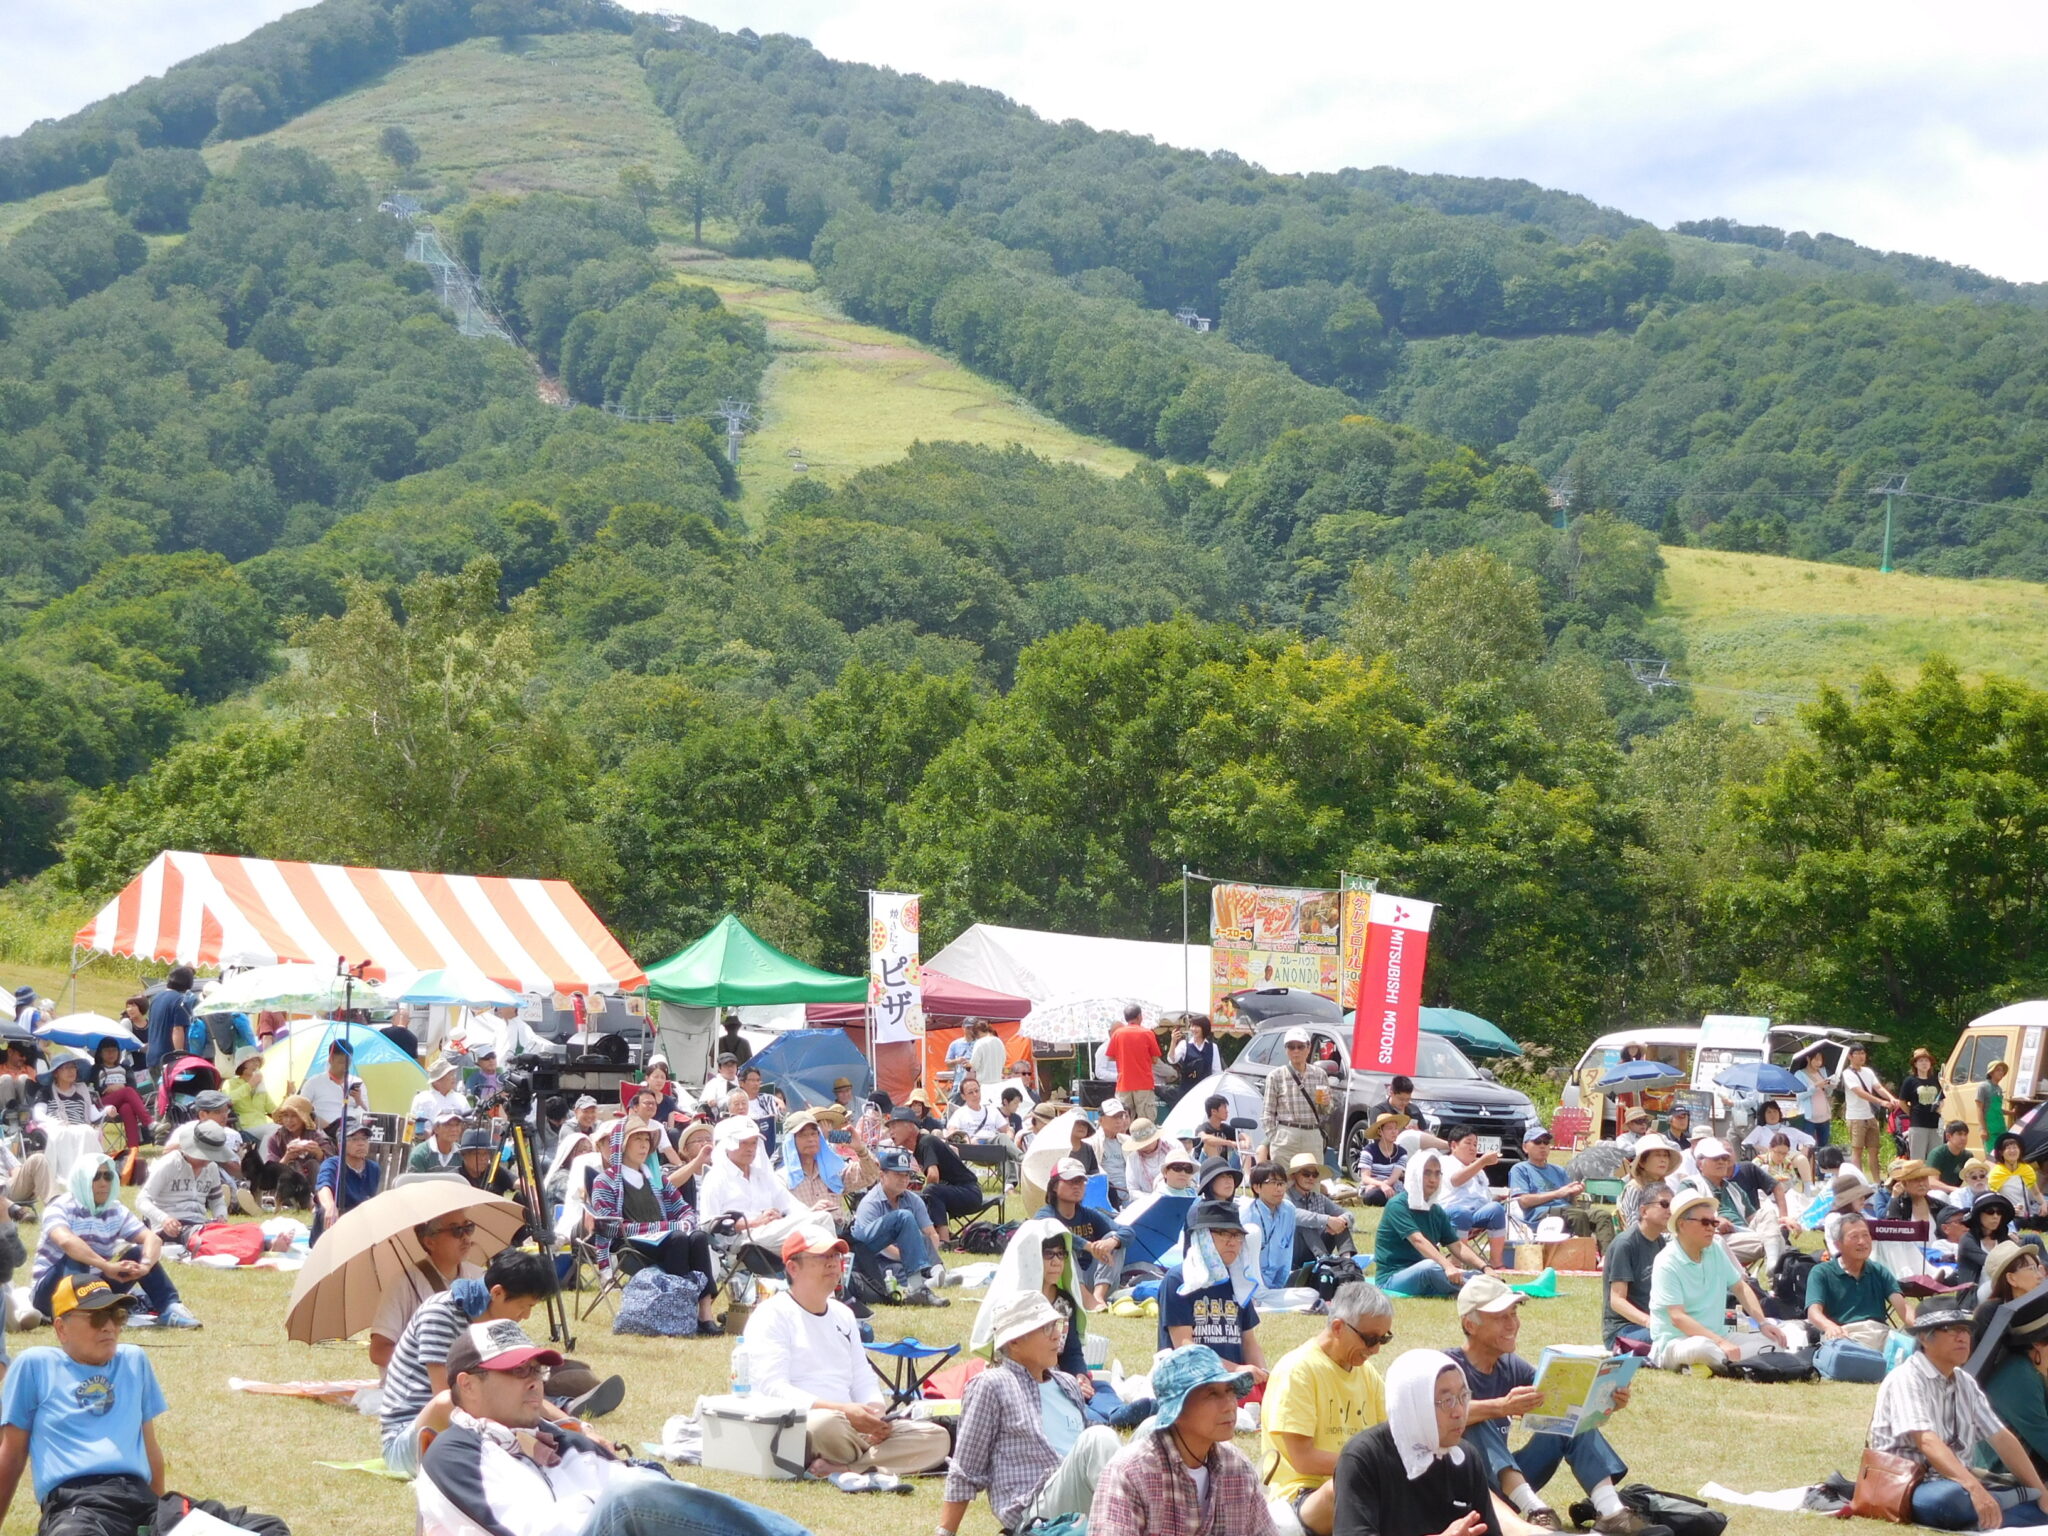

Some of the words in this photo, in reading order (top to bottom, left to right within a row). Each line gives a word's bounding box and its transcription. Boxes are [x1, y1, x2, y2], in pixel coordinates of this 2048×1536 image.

[1274, 967, 1319, 984] ANONDO
[1280, 956, 1315, 967] カレーハウス
[1385, 928, 1405, 1004] MITSUBISHI
[880, 956, 913, 1025] ピザ
[1378, 1010, 1398, 1065] MOTORS
[1875, 1226, 1897, 1234] SOUTH
